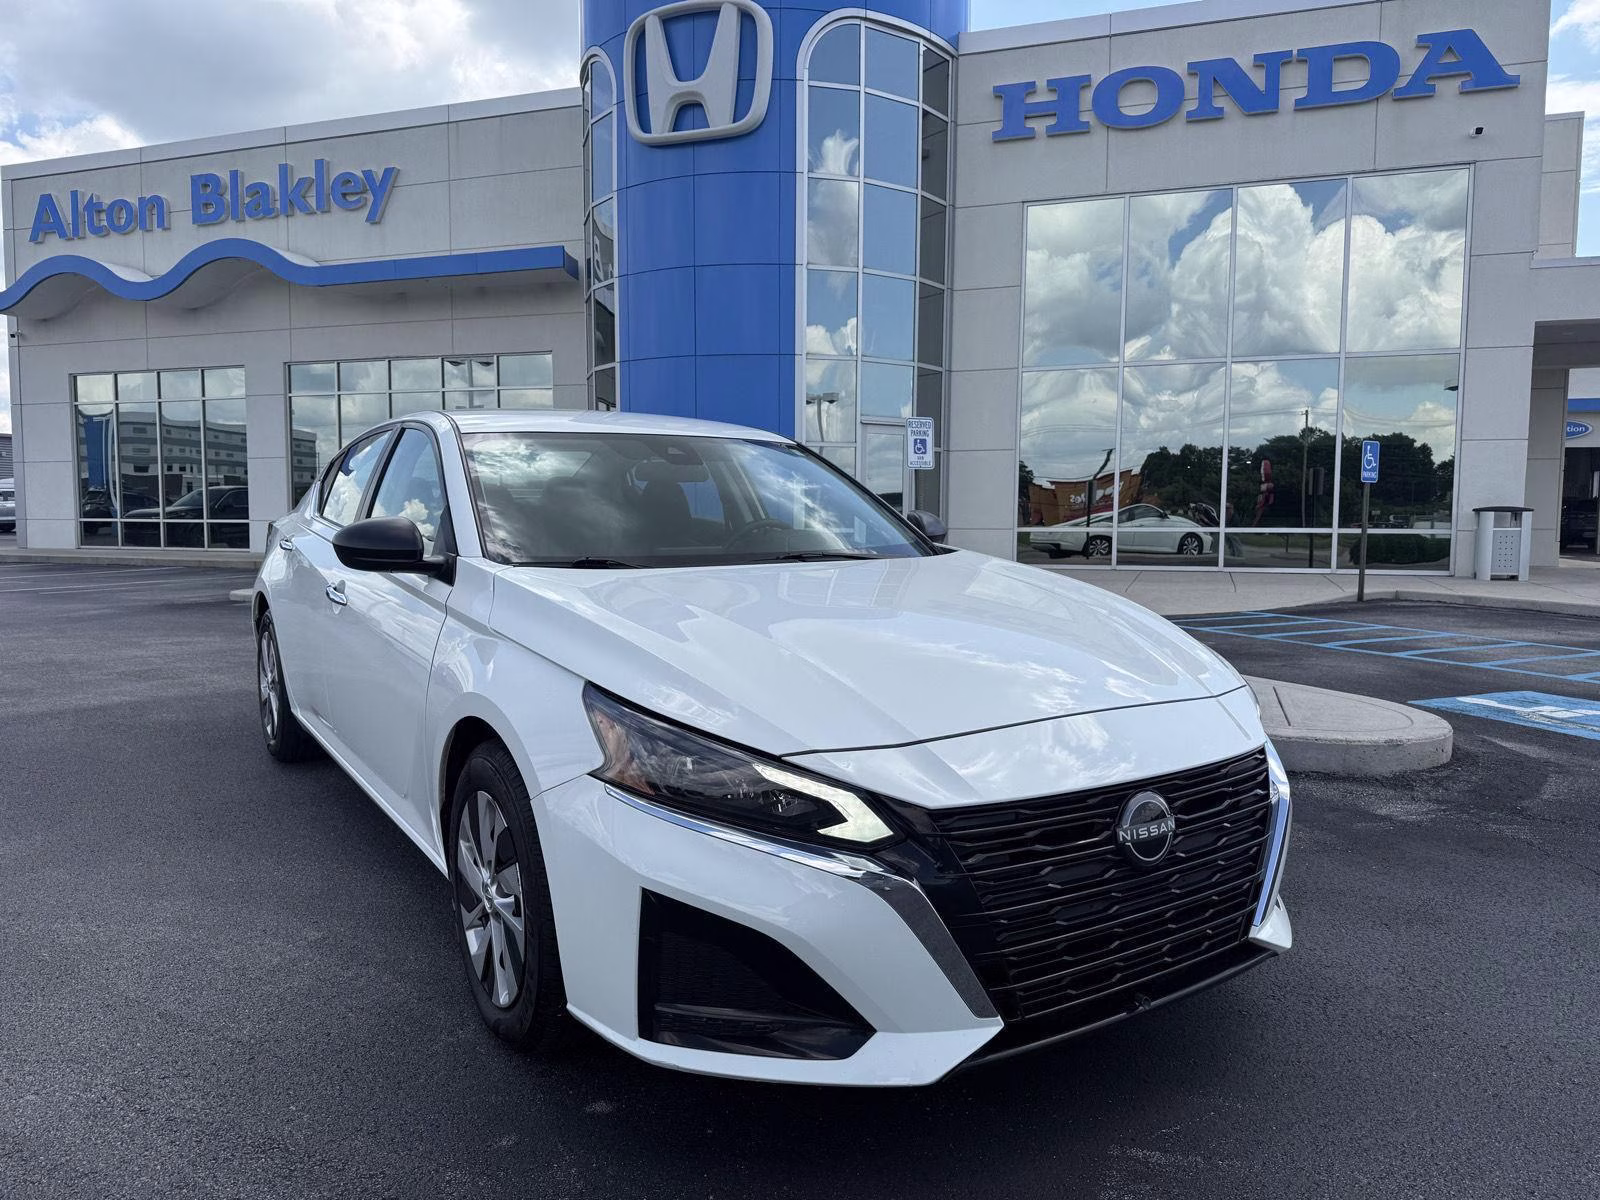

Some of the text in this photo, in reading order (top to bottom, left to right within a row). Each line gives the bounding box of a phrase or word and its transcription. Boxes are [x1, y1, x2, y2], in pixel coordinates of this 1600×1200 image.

[992, 28, 1521, 142] HONDA
[29, 159, 400, 243] Alton Blakley
[908, 420, 932, 430] RESERVED
[910, 429, 930, 438] PARKING
[1361, 470, 1377, 479] PARKING
[1119, 820, 1176, 842] NISSAN
